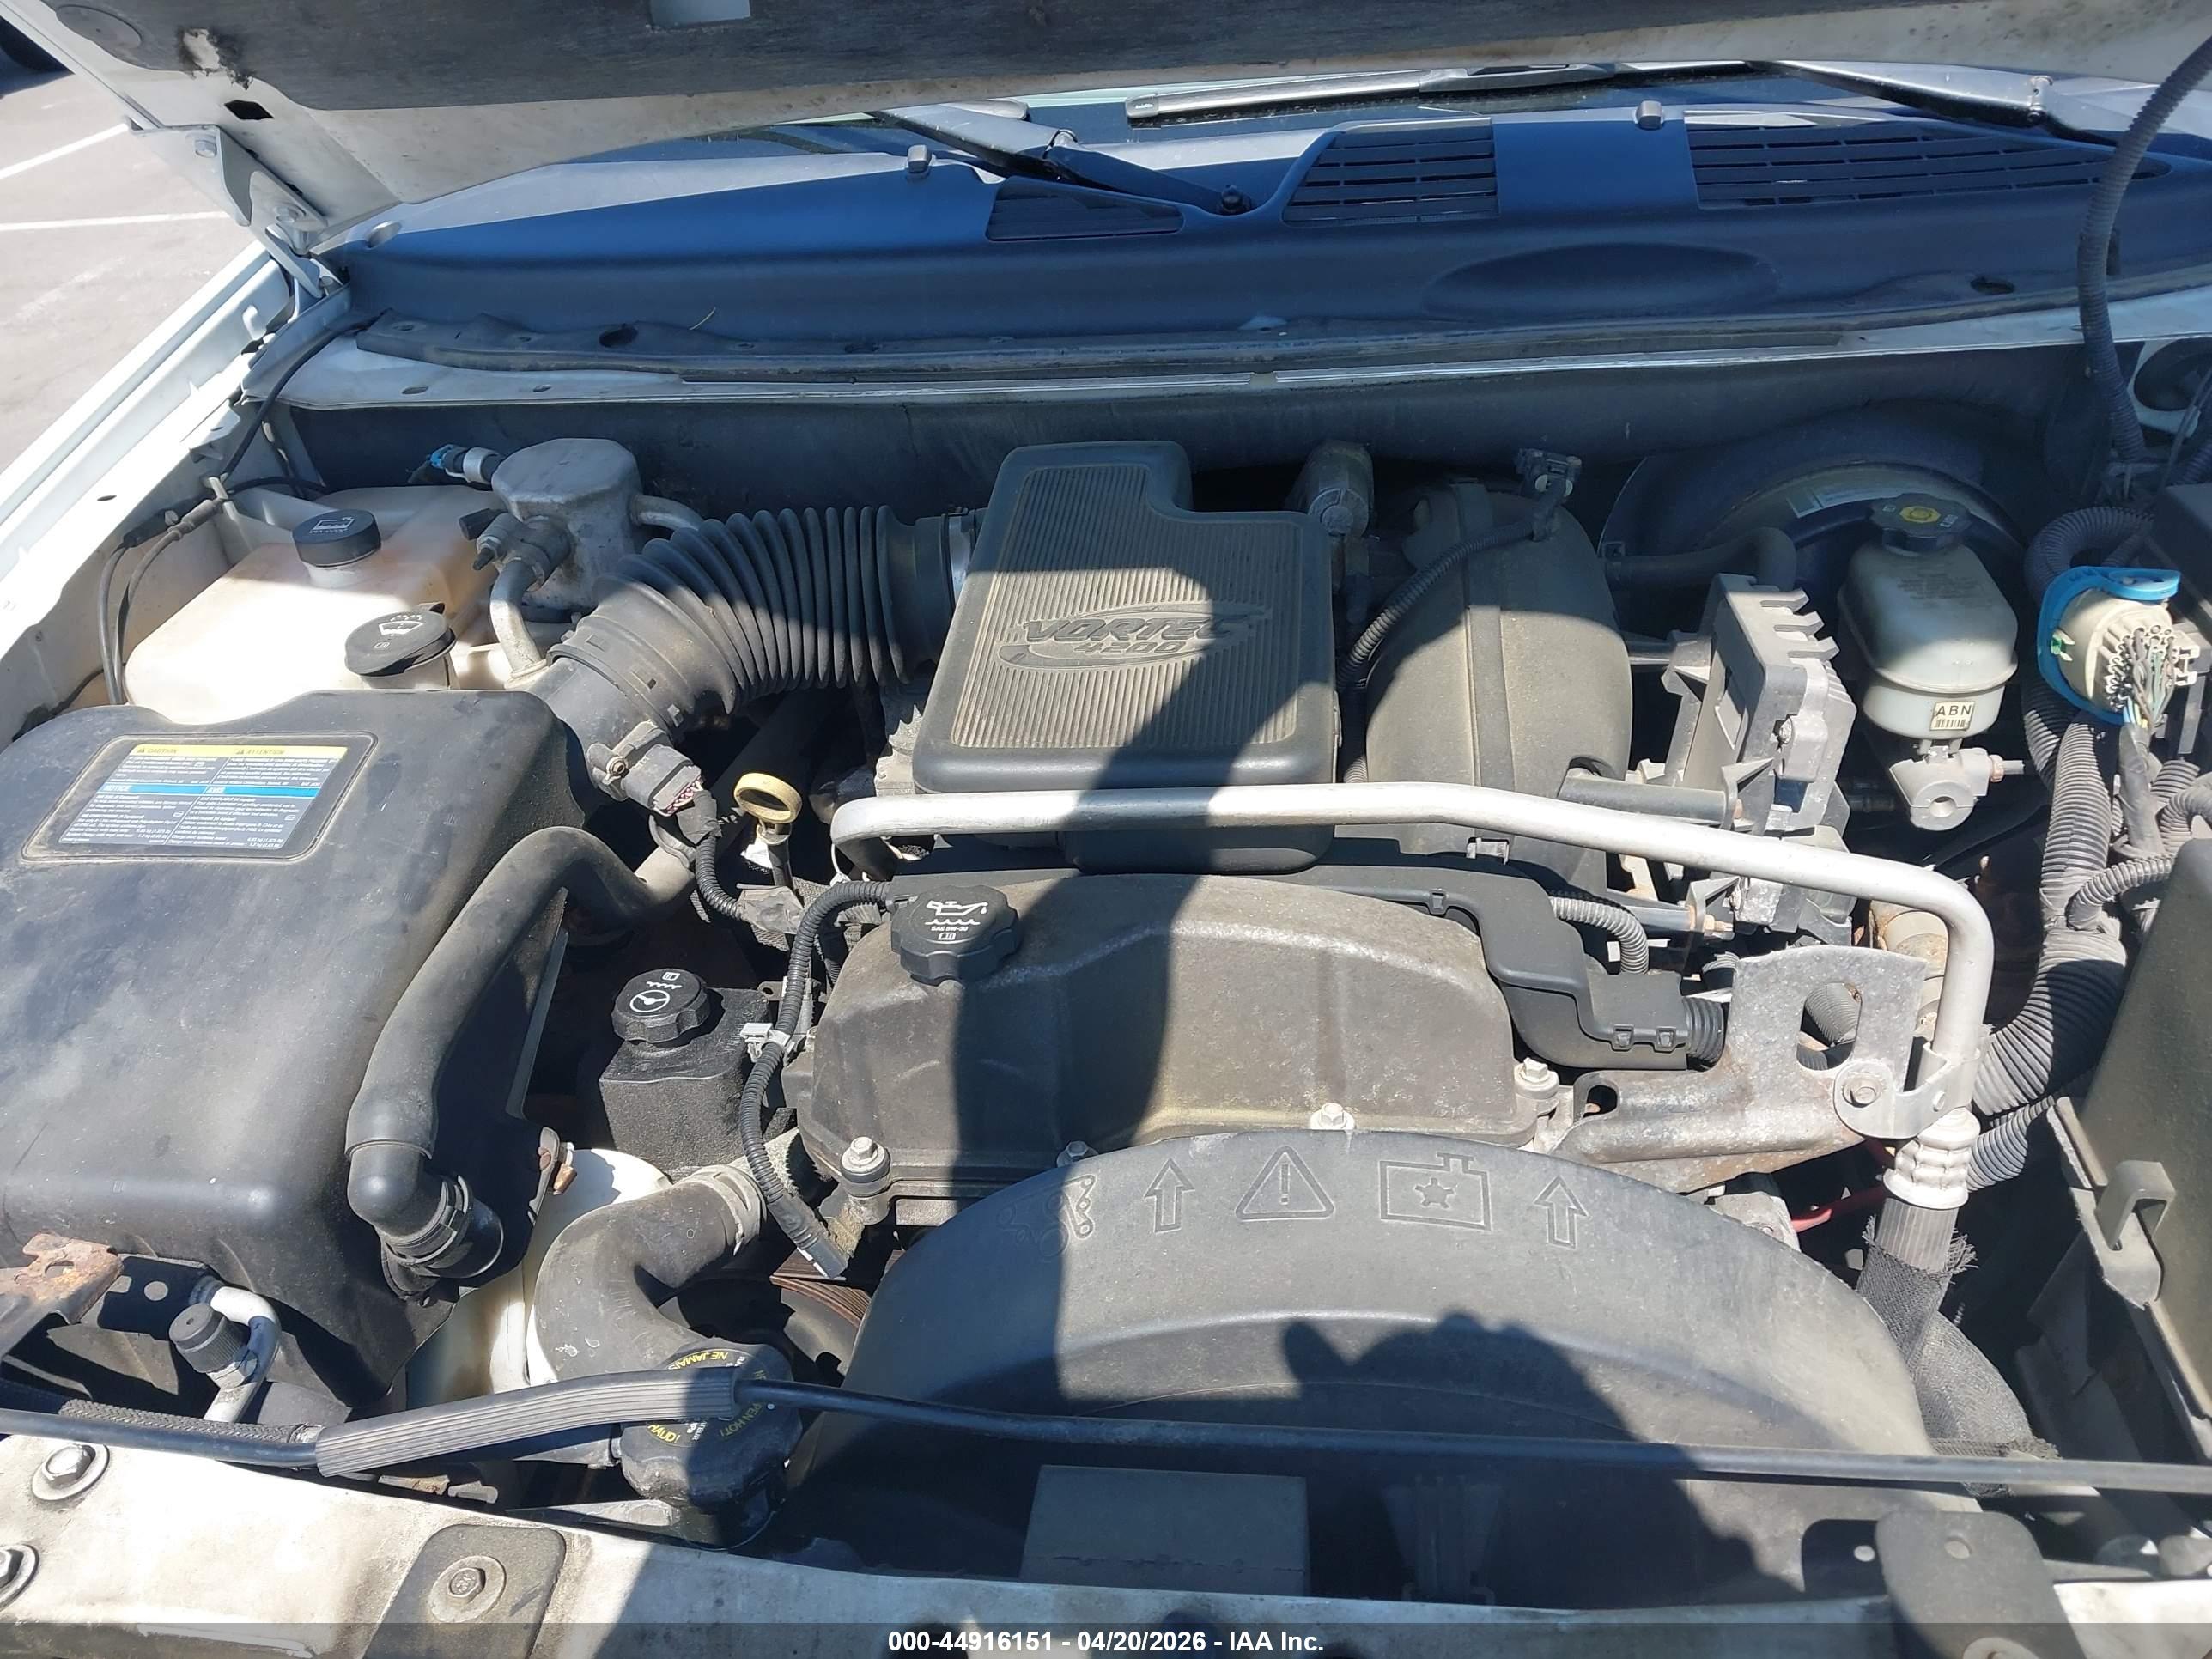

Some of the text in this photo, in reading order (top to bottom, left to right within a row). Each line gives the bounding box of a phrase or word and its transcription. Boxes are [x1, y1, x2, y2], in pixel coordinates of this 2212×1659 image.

[1023, 617, 1249, 642] VORTEC
[1073, 641, 1188, 654] 4200
[1936, 704, 1972, 716] ABN
[667, 1351, 710, 1370] JAMAIS
[710, 1351, 729, 1360] NE
[647, 1424, 681, 1443] HAUD!
[720, 1419, 746, 1437] HOT!
